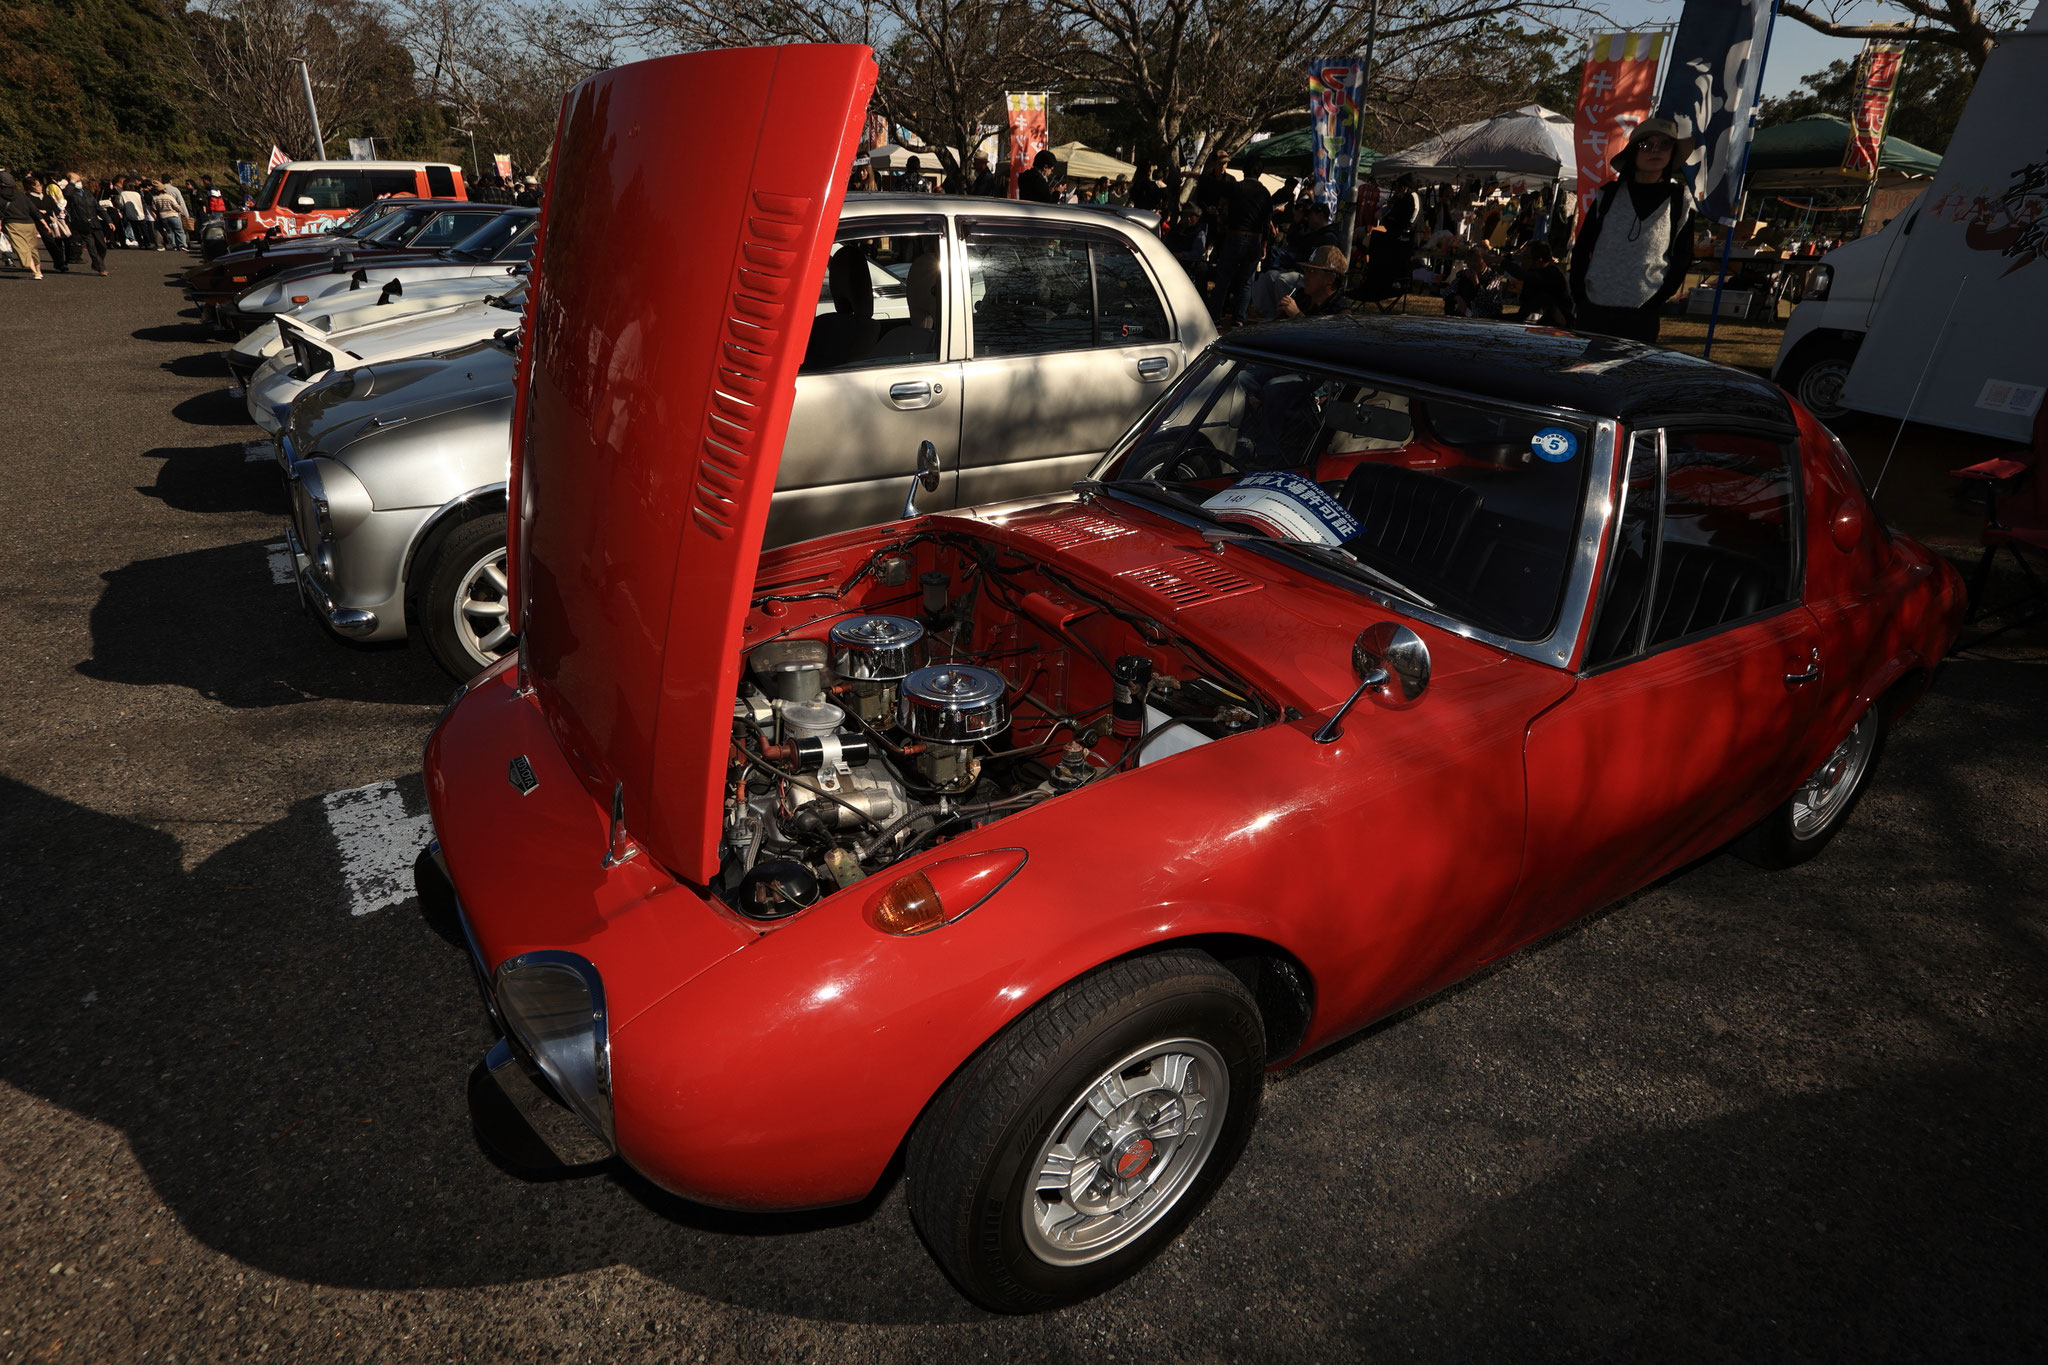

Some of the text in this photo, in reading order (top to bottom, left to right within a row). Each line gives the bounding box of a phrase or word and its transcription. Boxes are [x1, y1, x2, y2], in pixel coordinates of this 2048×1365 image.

[1548, 439, 1561, 450] 5
[1224, 494, 1247, 503] 148
[1236, 475, 1356, 537] 車両入場許可証
[515, 757, 536, 788] TOYOTA
